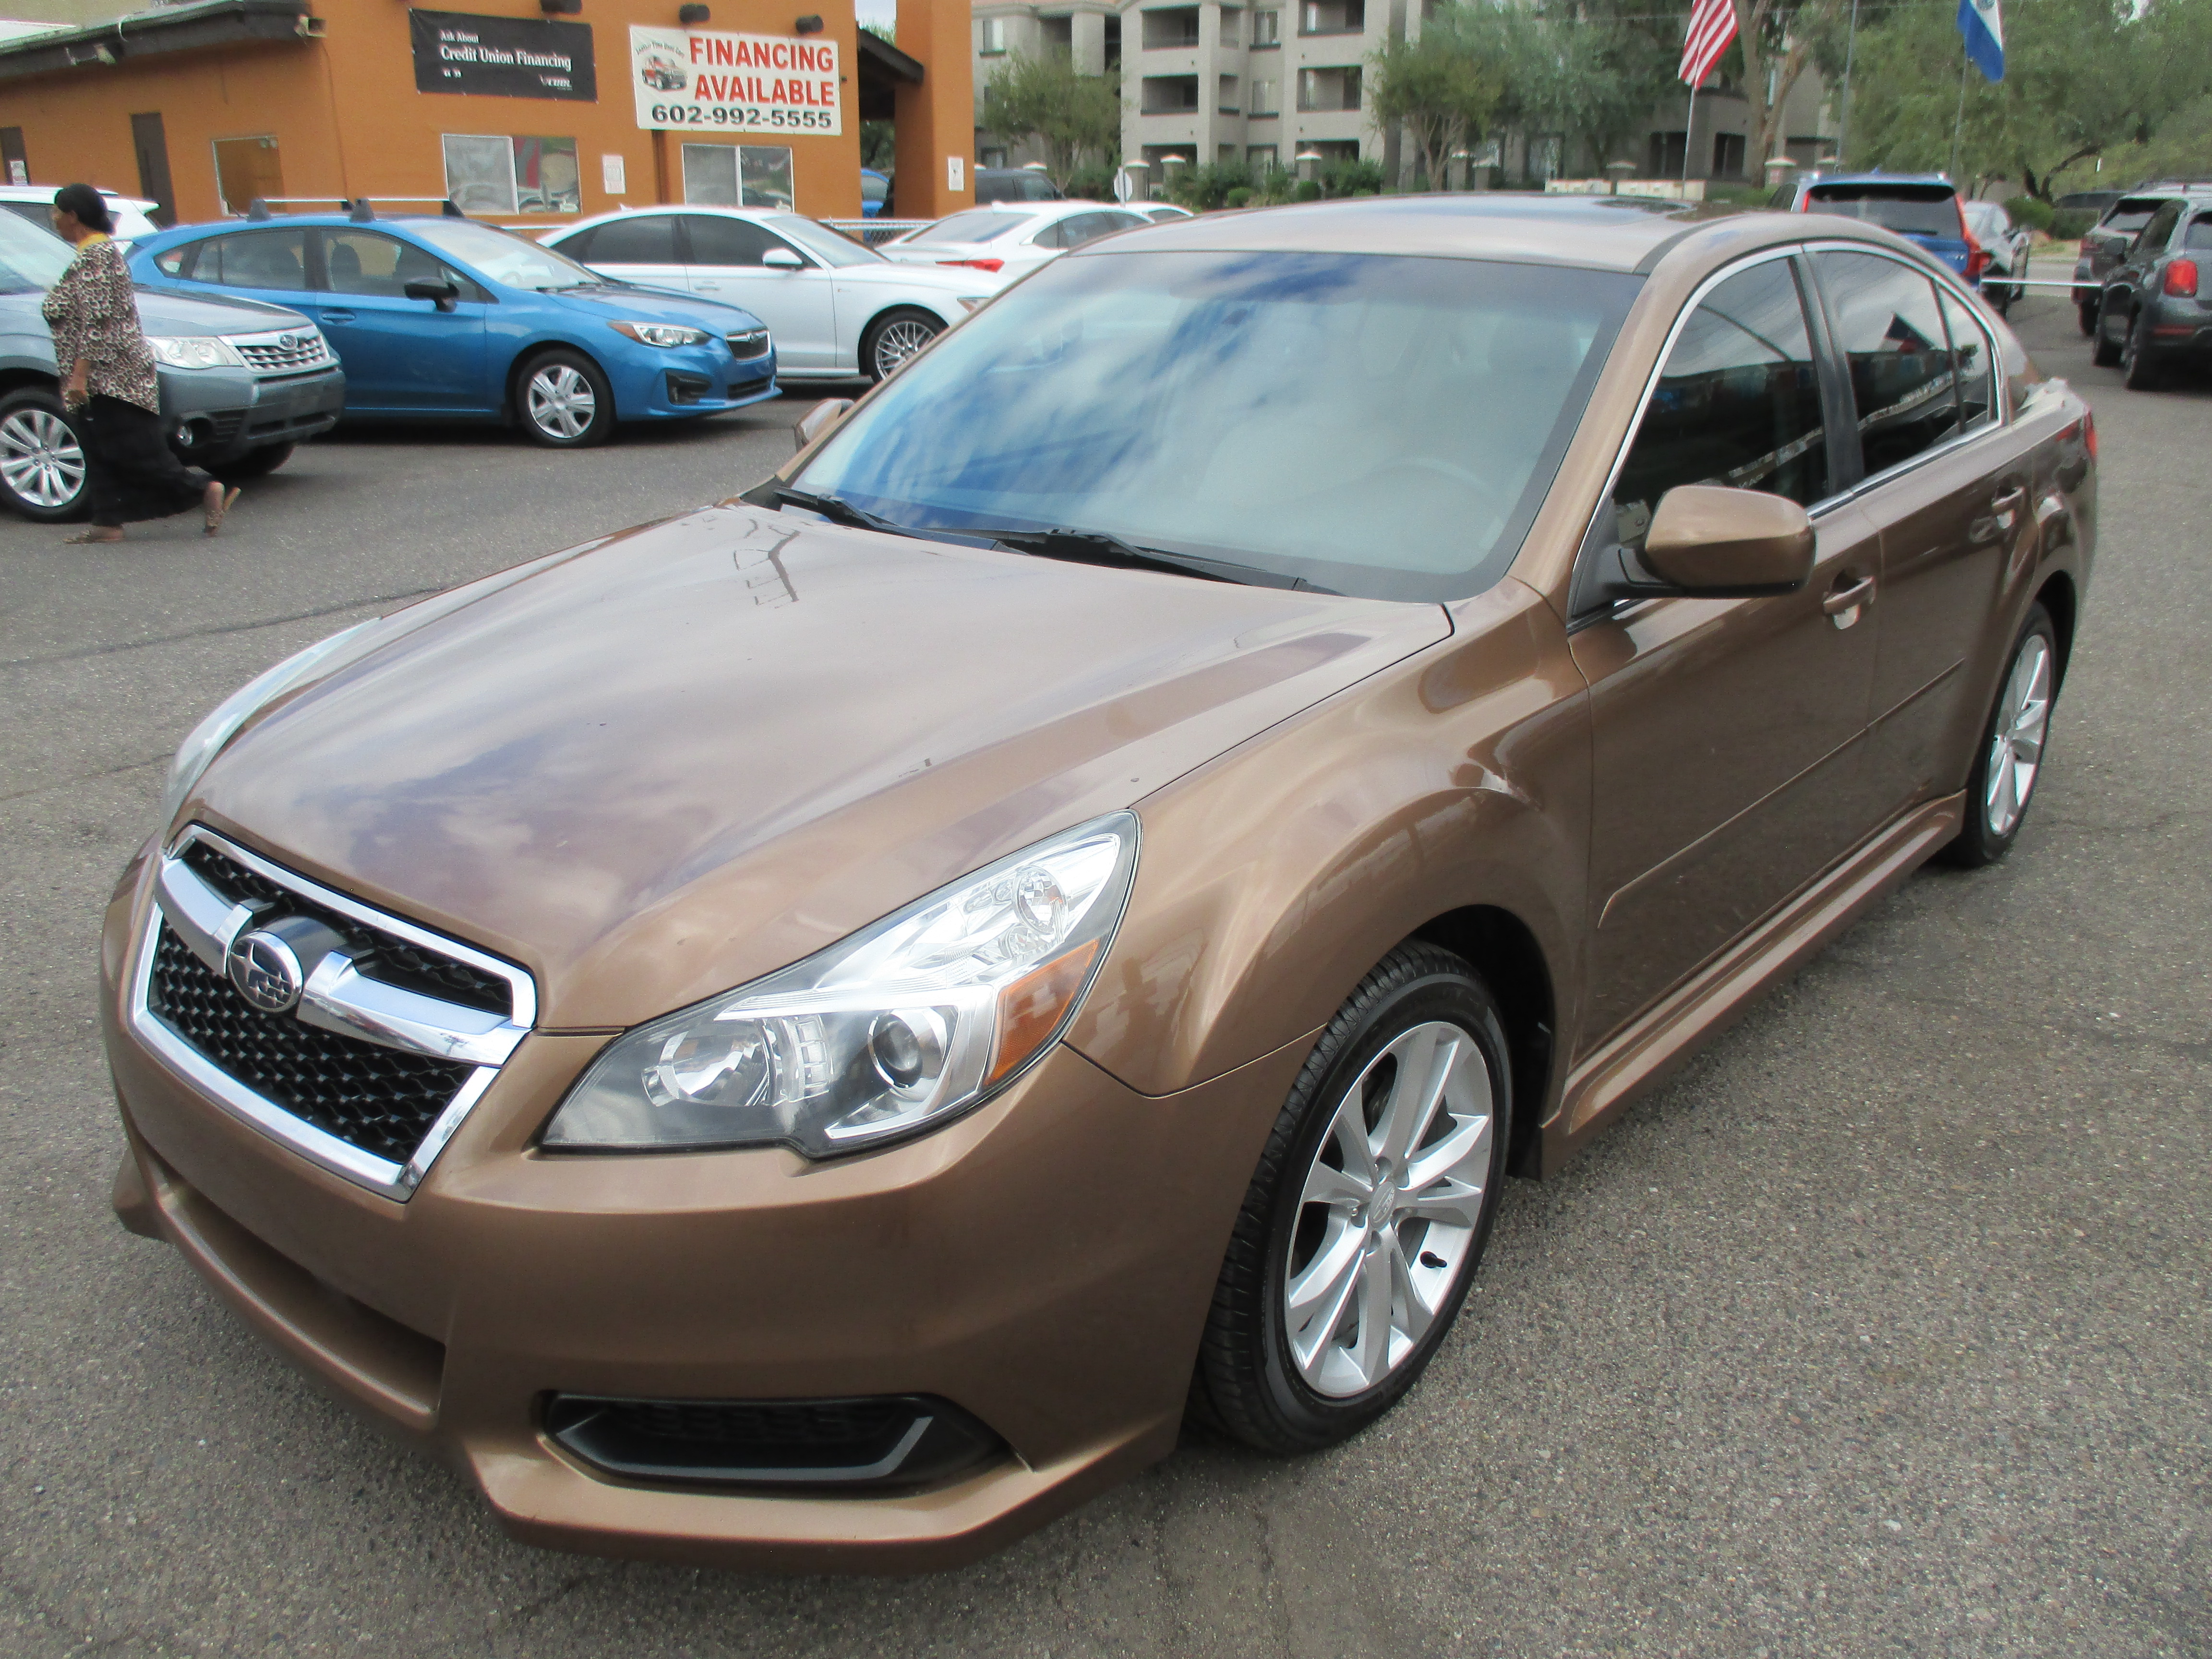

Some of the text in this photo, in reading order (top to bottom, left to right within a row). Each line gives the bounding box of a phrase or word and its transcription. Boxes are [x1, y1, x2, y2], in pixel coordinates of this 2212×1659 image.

[439, 30, 480, 44] Ask About
[440, 44, 572, 72] Credit Union Financing
[689, 37, 834, 73] FINANCING
[695, 74, 835, 107] AVAILABLE
[651, 103, 832, 129] 602-992-5555
